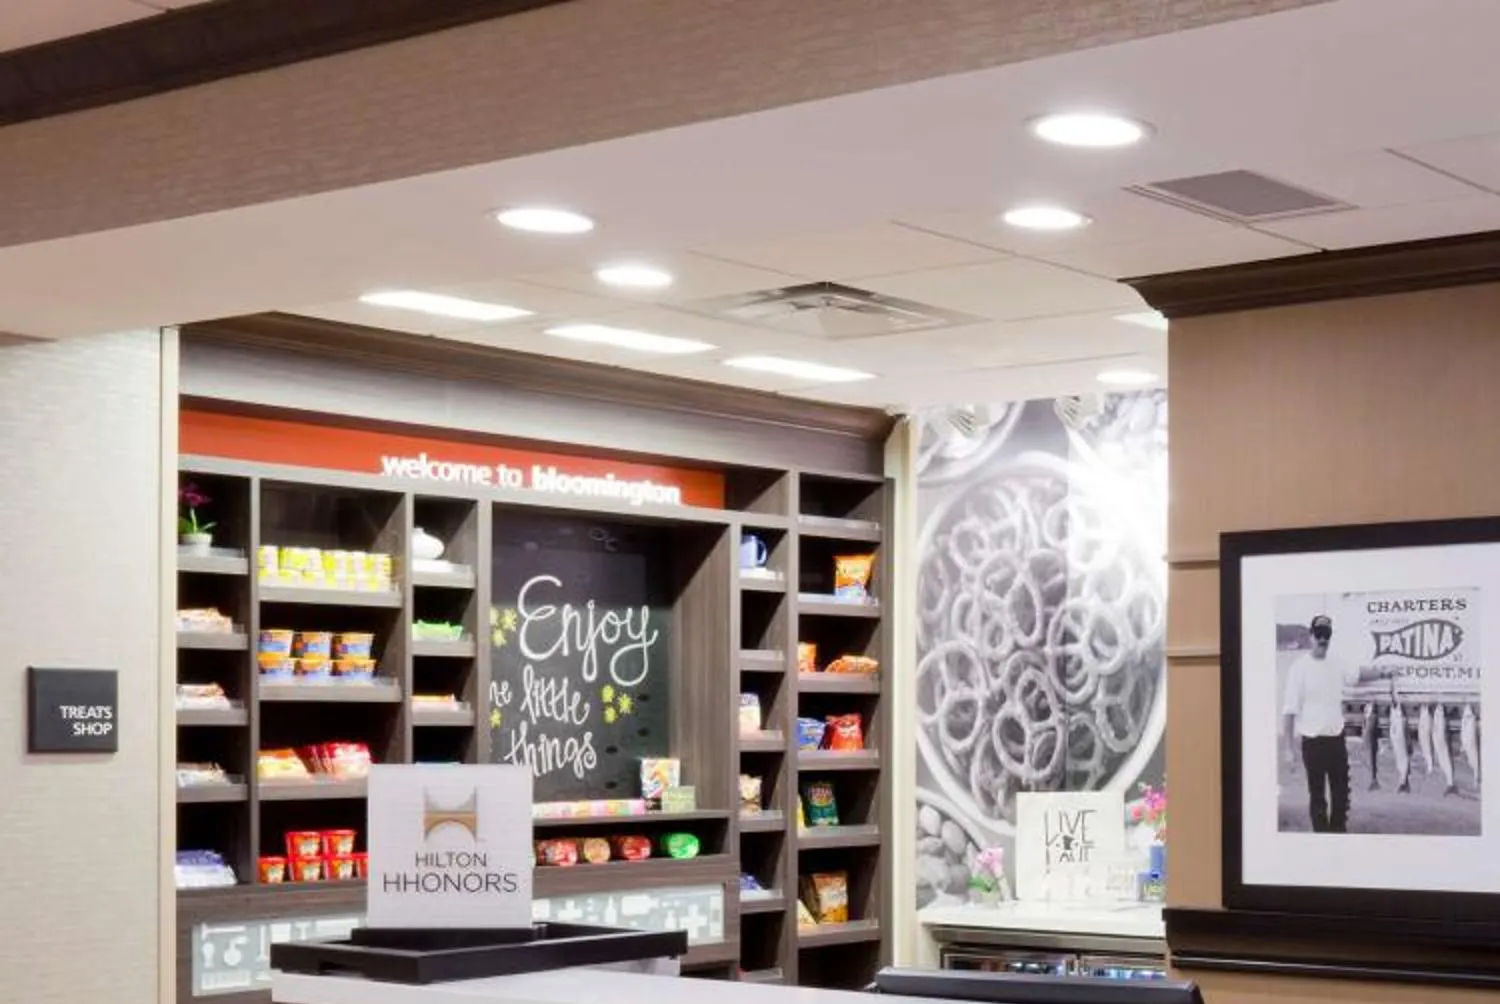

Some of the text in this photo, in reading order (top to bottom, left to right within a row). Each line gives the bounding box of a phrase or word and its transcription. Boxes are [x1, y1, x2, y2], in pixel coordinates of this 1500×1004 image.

[380, 453, 682, 505] welcome to bloomington
[1367, 598, 1467, 613] CHARTERS
[517, 574, 659, 687] Enjoy
[1379, 622, 1454, 657] PATINA
[520, 664, 591, 726] little
[59, 704, 113, 719] TREATS
[73, 721, 113, 736] SHOP
[504, 720, 597, 779] things
[415, 851, 488, 868] HILTON
[383, 872, 518, 893] HHONORS
